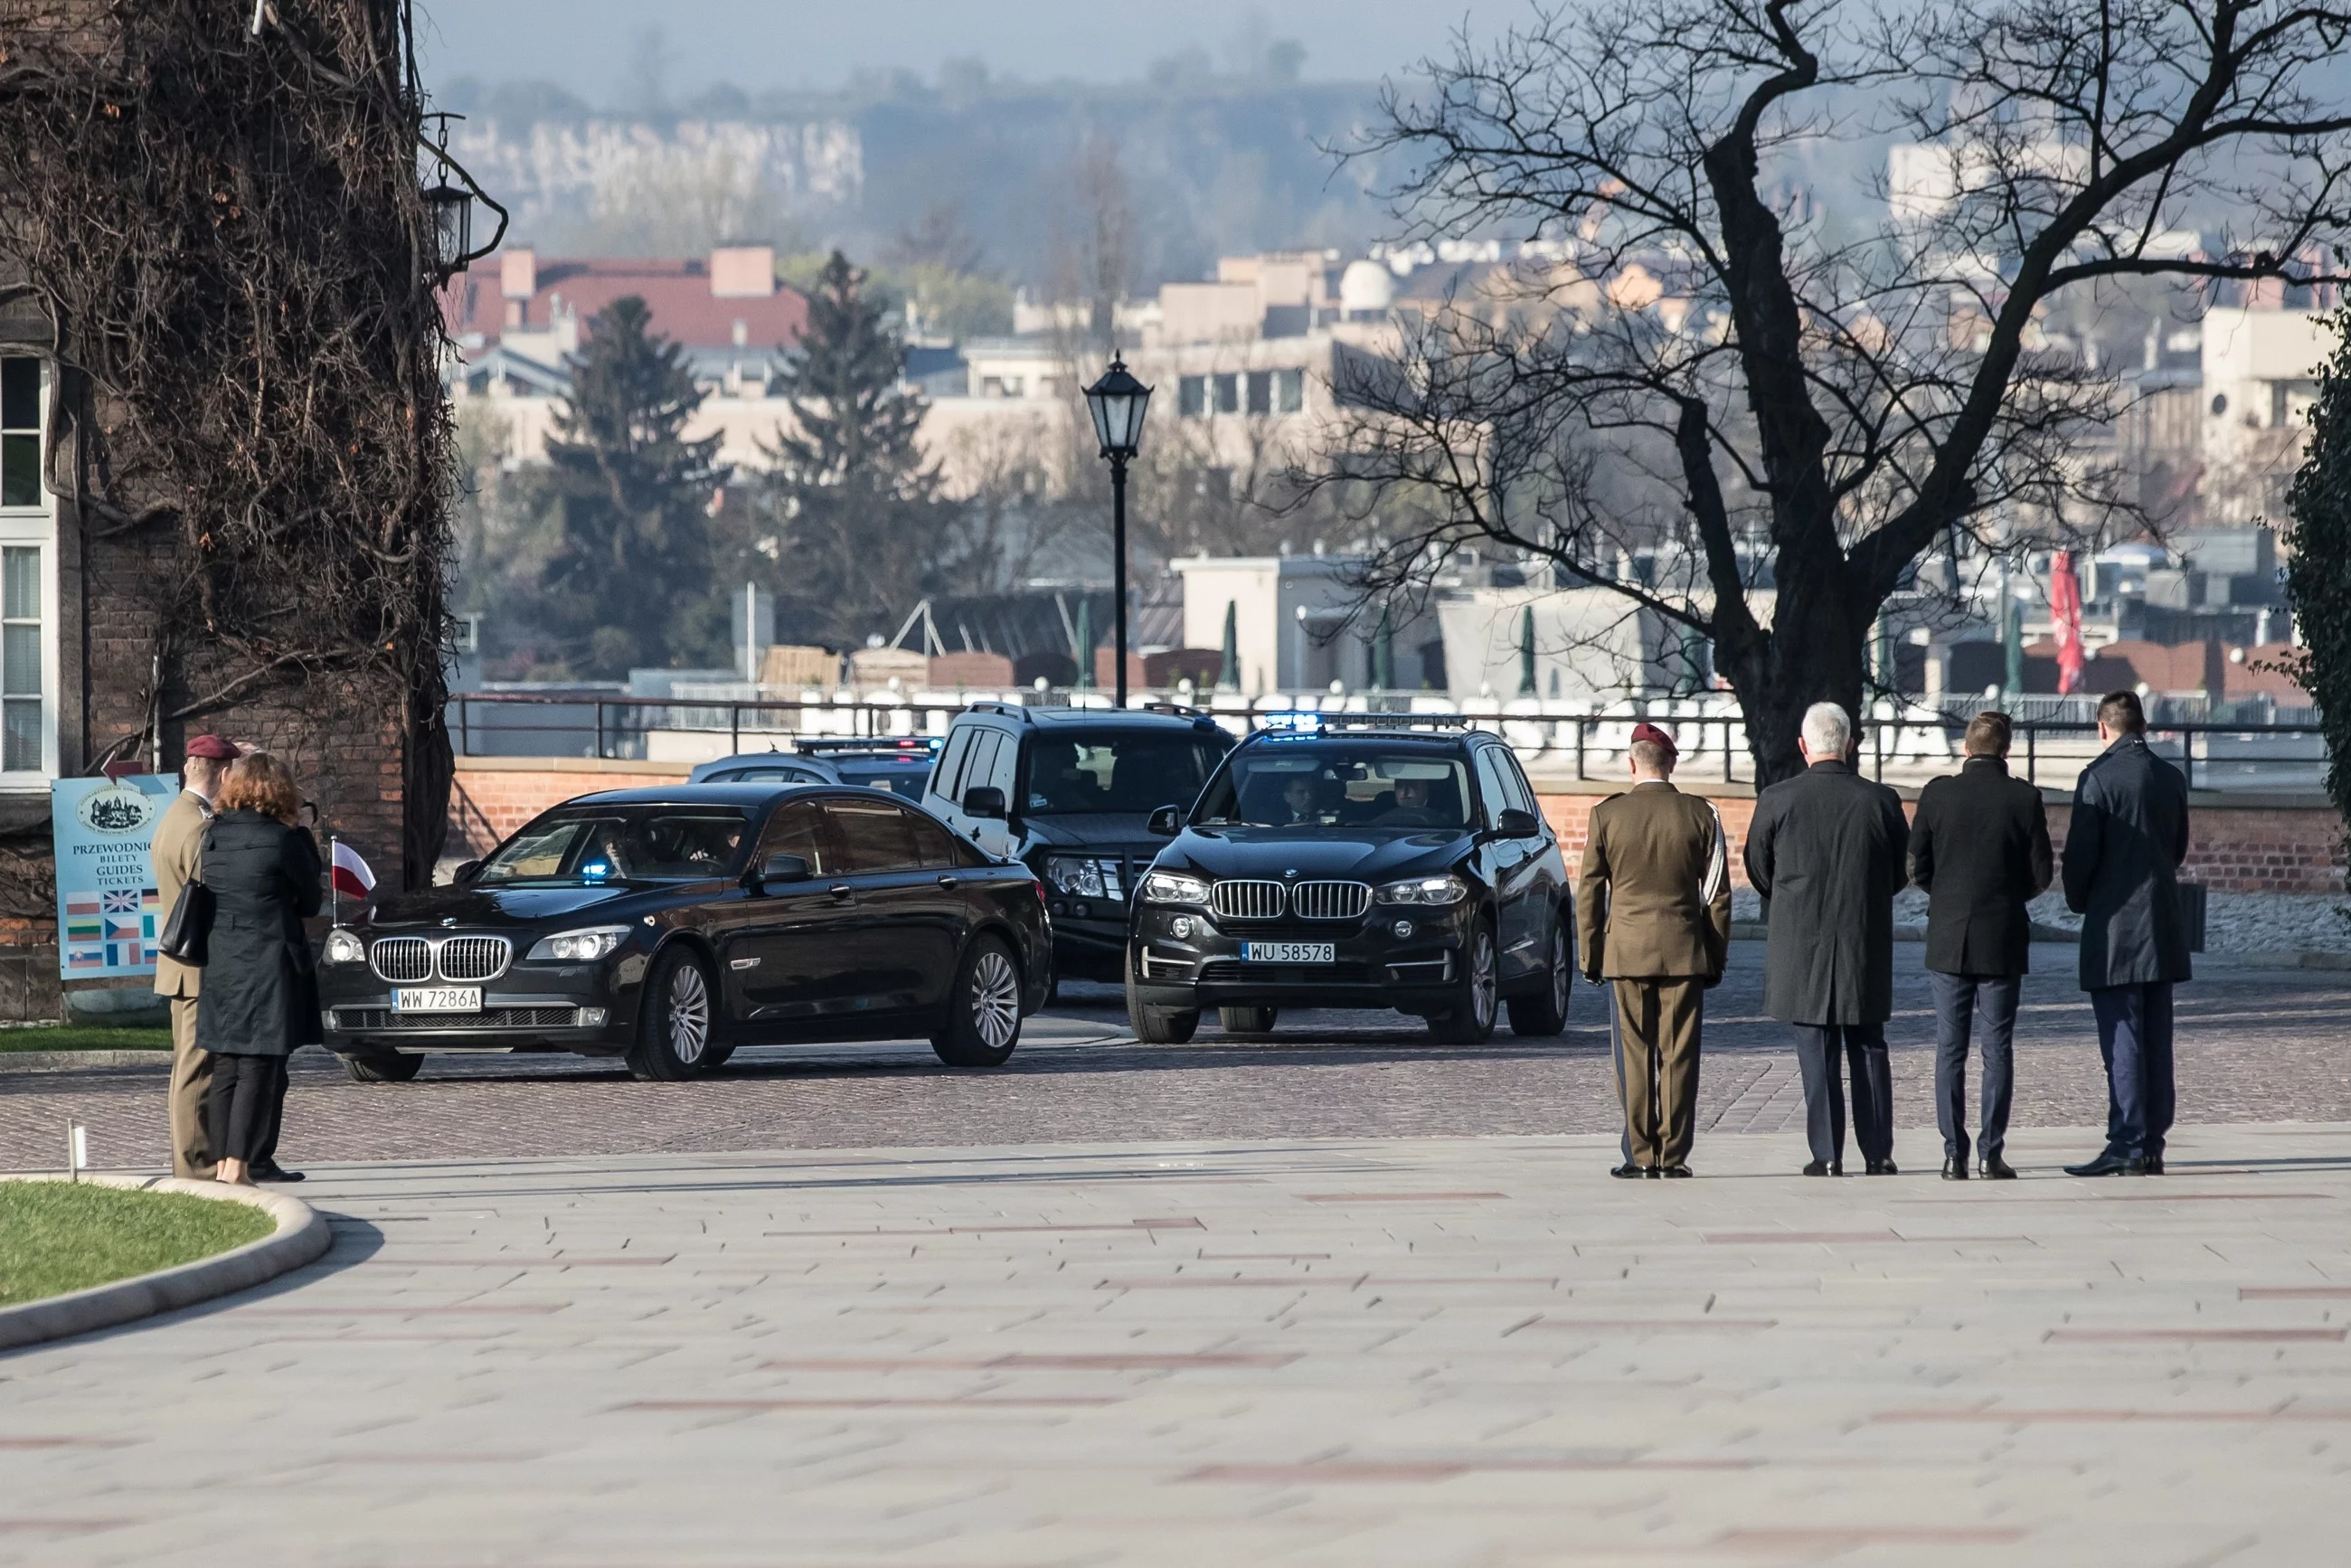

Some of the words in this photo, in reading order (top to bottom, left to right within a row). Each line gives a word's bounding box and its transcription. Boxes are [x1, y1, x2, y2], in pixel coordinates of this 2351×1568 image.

[99, 855, 137, 863] BILETY
[96, 864, 143, 875] GUIDES
[97, 875, 144, 885] TICKETS
[1251, 944, 1275, 960] WU
[1280, 944, 1332, 961] 58578
[401, 990, 422, 1008] WW
[428, 989, 478, 1007] 7286A
